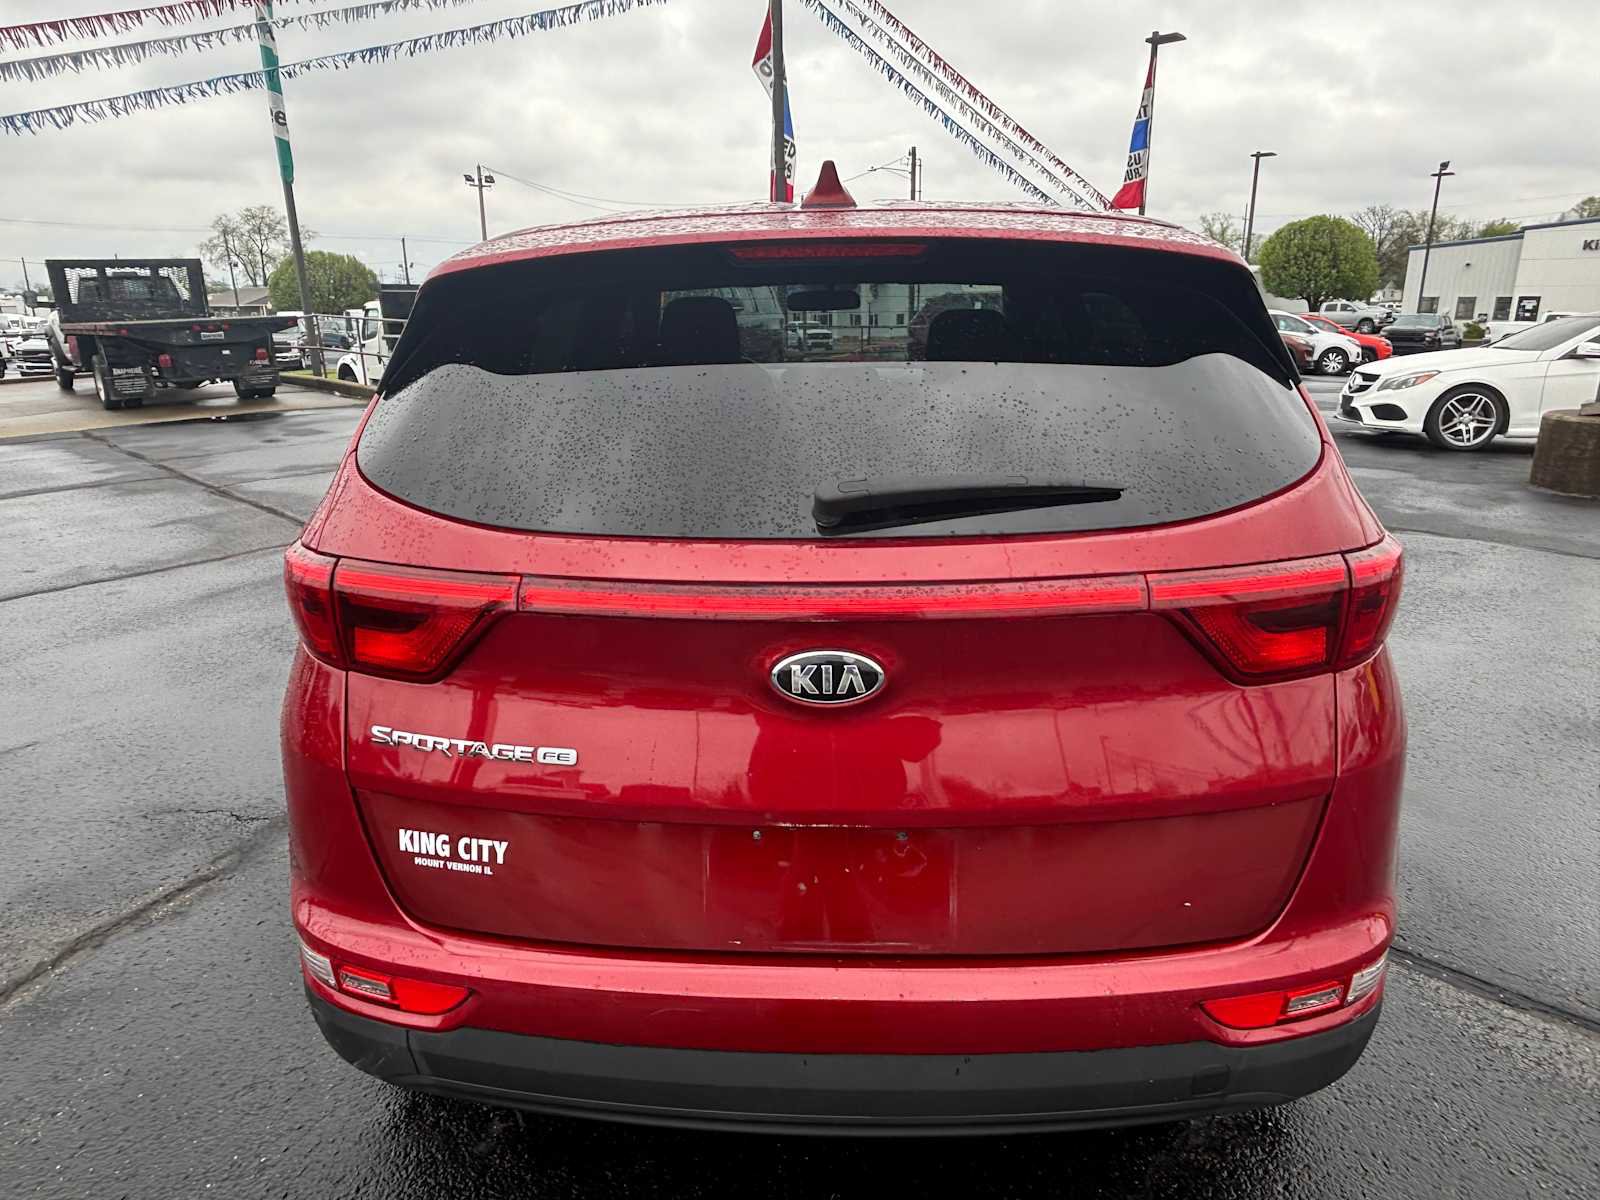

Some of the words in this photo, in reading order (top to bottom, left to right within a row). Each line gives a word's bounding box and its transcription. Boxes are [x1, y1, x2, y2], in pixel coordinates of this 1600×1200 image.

[790, 665, 866, 694] KIA
[370, 725, 535, 763] SPORTAGE
[398, 828, 450, 857] KING
[458, 837, 509, 864] CITY
[414, 857, 444, 869] MOUNT
[446, 861, 482, 874] VERNON
[484, 866, 493, 875] IL
